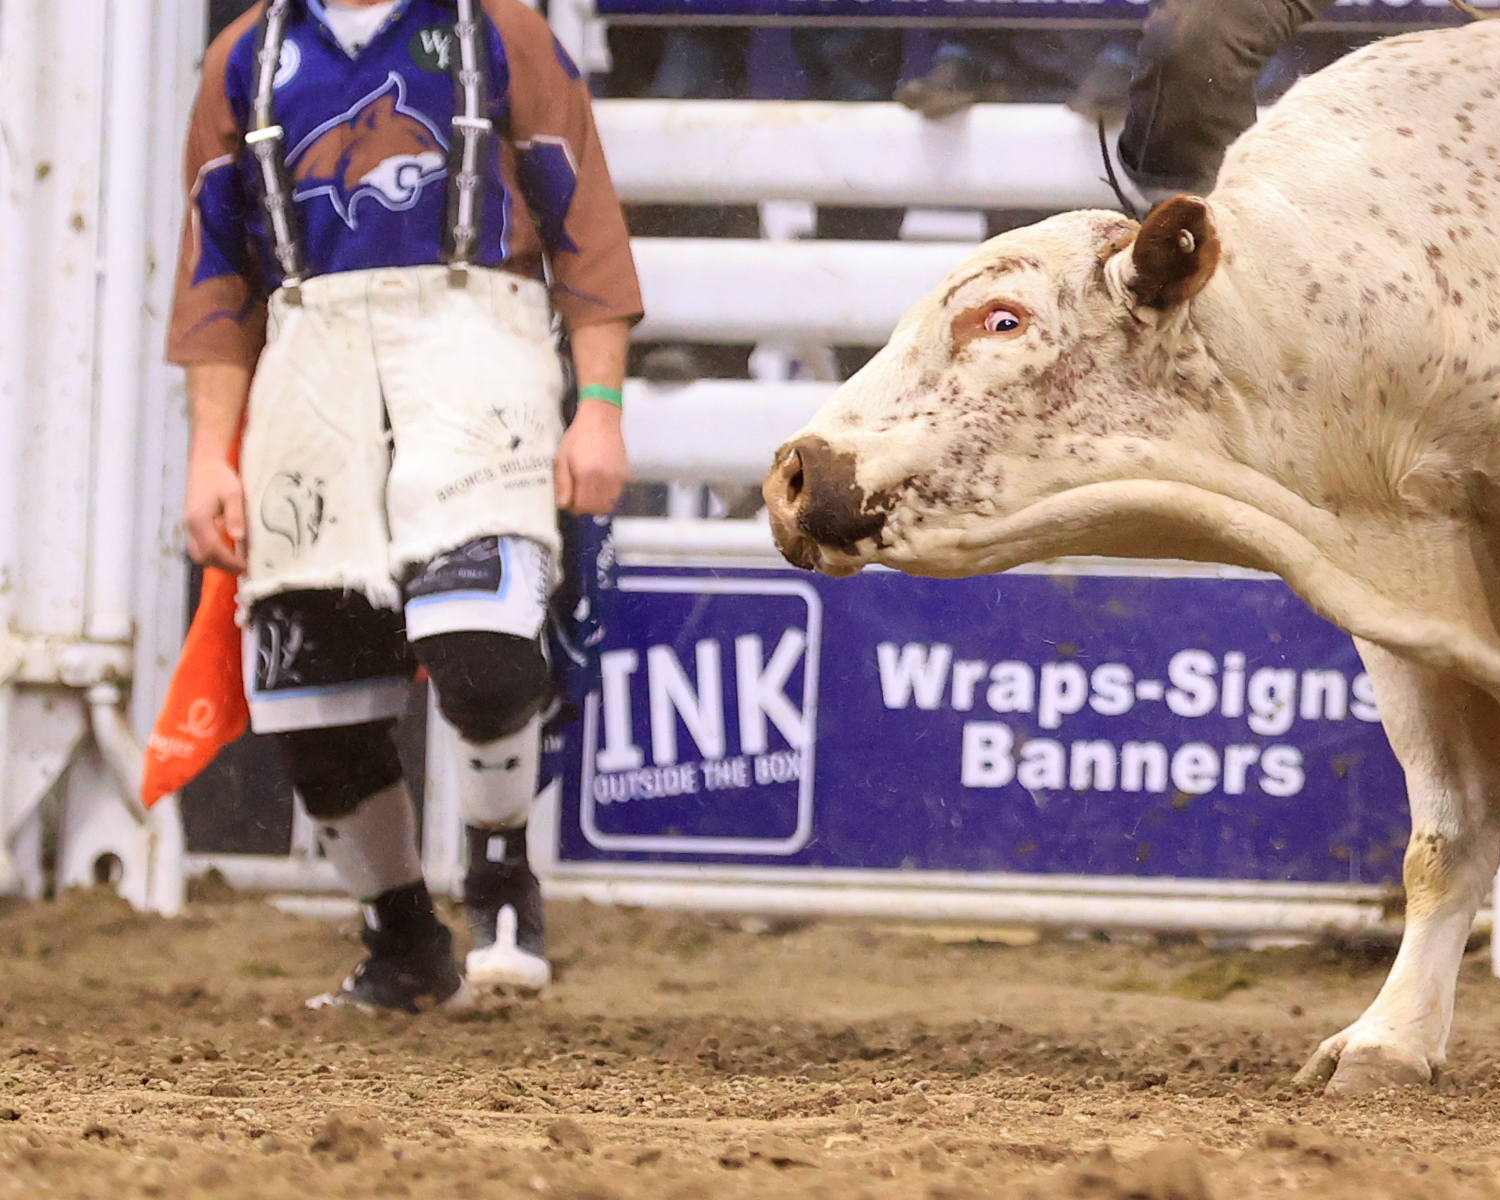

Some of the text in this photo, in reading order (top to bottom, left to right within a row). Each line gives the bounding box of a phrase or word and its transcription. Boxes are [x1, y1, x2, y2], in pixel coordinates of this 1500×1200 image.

[595, 625, 812, 775] INK
[876, 641, 1384, 737] Wraps-Signs
[593, 750, 801, 805] OUTSIDE THE BOX
[960, 720, 1306, 798] Banners
